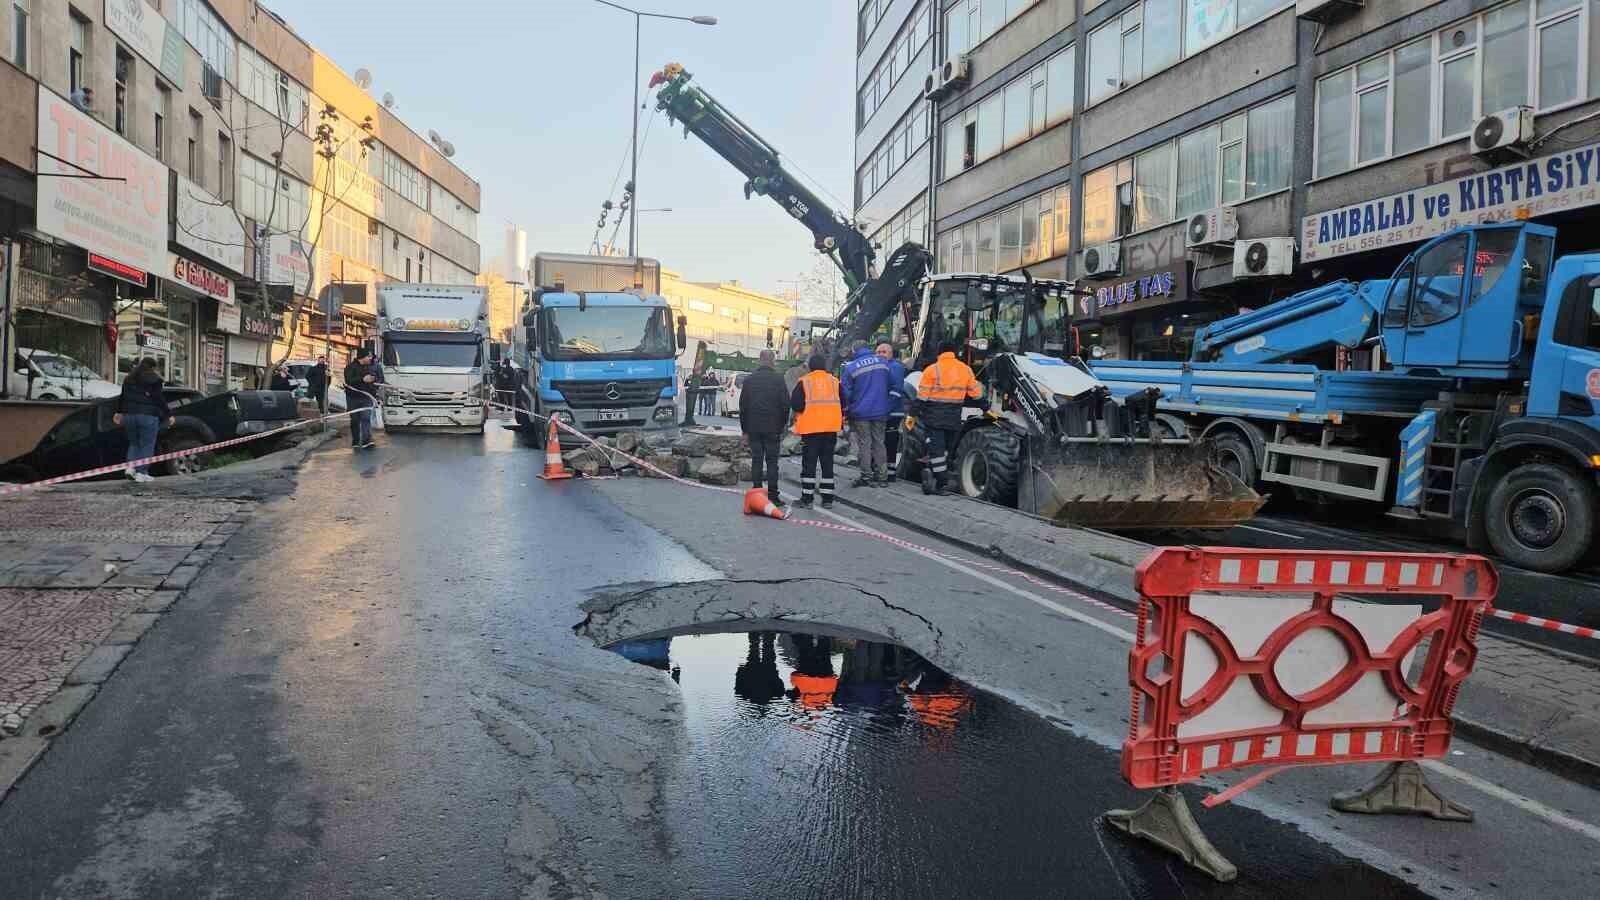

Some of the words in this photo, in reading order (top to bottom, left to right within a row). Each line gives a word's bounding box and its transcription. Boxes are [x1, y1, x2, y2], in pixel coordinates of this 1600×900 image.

[51, 103, 161, 217] TEMPO
[1318, 194, 1415, 244] AMBALAJ
[1424, 193, 1450, 220] ve
[1478, 208, 1512, 223] FAX:
[1329, 241, 1356, 255] TEL:
[1360, 235, 1382, 249] 556
[1408, 225, 1424, 238] 17
[1097, 281, 1137, 307] BLUE
[1140, 271, 1172, 298] TAŞ
